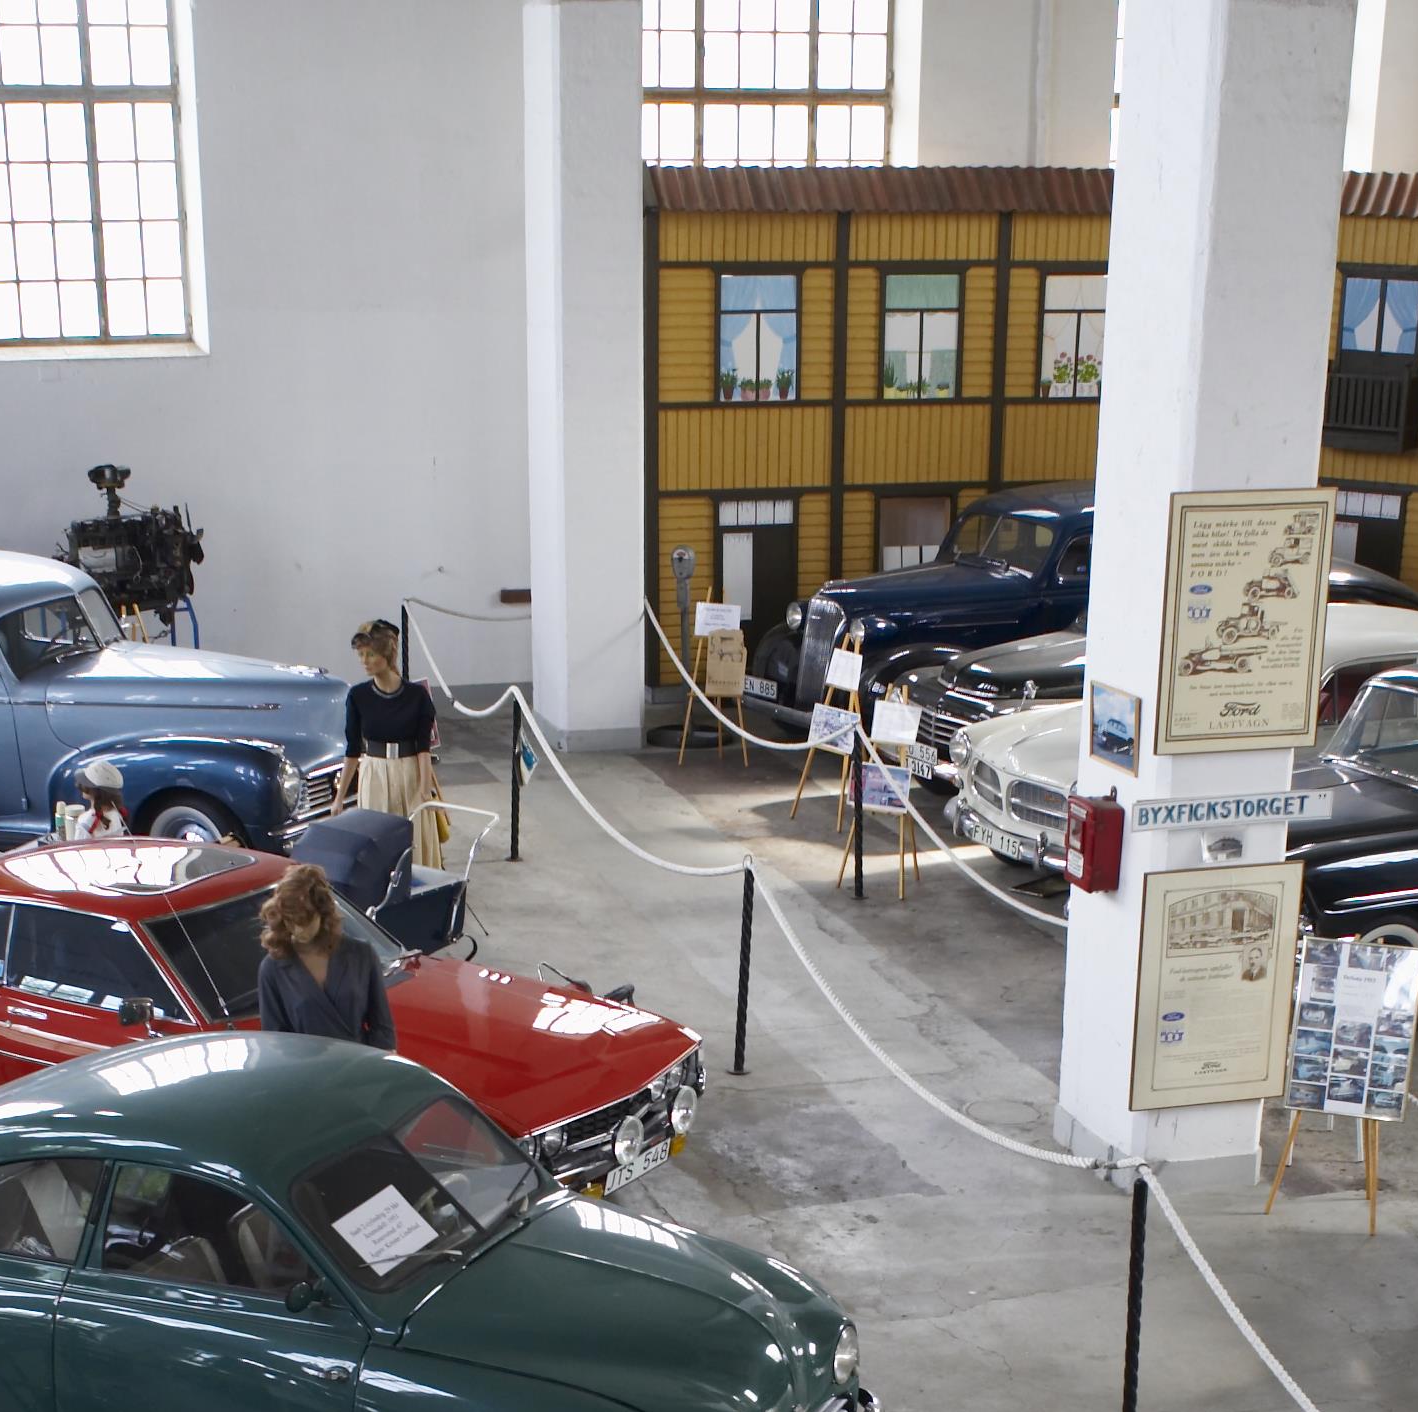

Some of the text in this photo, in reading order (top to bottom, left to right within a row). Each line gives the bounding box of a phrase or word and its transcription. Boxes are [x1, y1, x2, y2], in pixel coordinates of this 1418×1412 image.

[1219, 701, 1262, 718] Ford
[974, 825, 1017, 855] FYH 115
[607, 1142, 668, 1192] JTS 548
